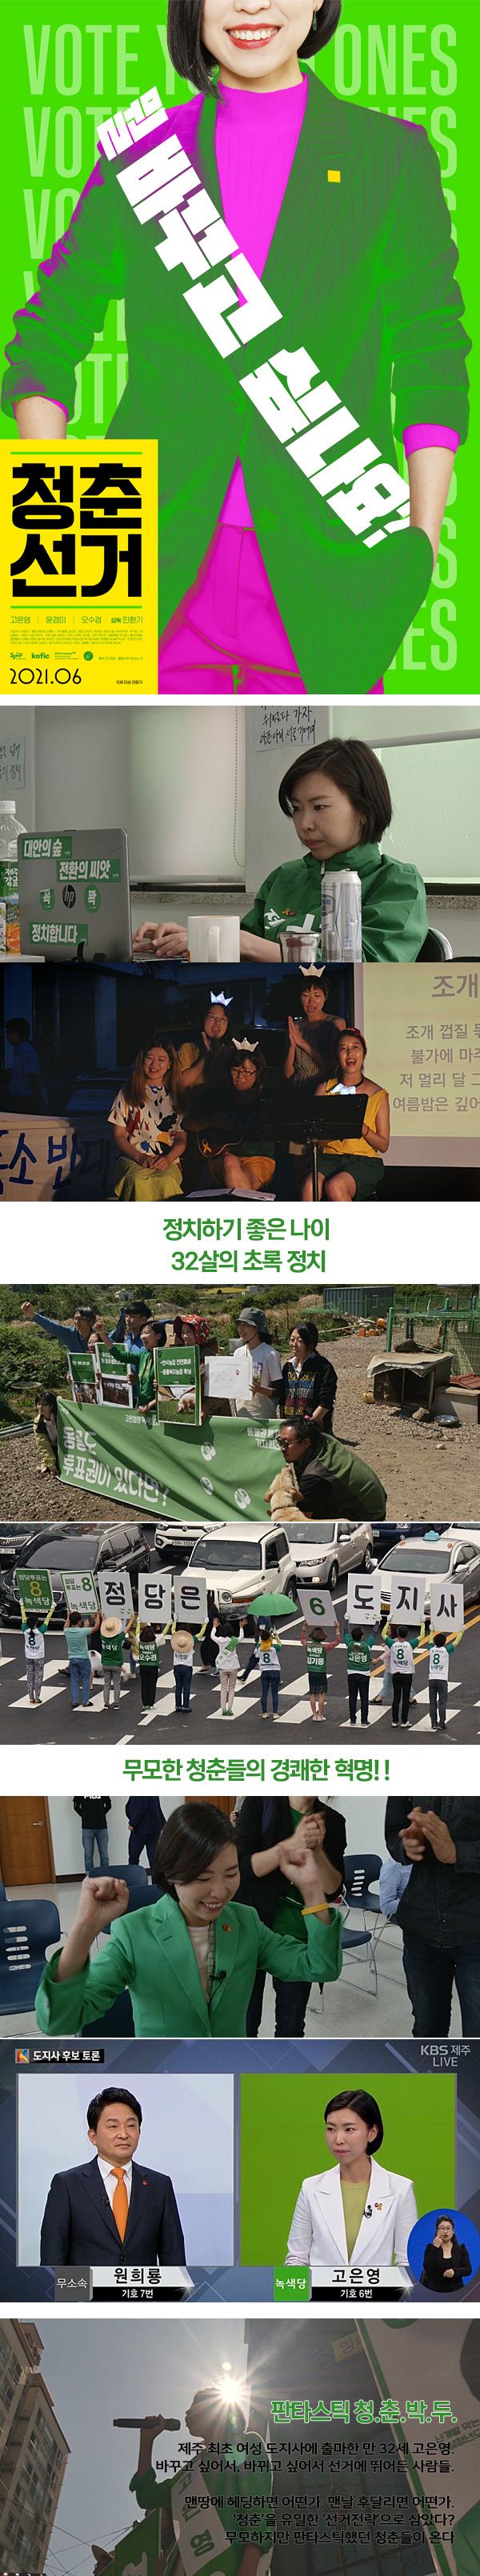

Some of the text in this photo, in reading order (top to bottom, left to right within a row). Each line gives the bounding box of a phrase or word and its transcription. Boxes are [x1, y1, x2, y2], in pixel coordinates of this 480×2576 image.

[23, 23, 140, 96] VOTE
[334, 23, 458, 96] ONES
[96, 86, 169, 161] 뭘
[116, 133, 282, 359] 바꾸고
[11, 463, 142, 530] 청춘
[10, 534, 142, 597] 선거
[10, 615, 31, 624] 고은영
[46, 615, 66, 624] 윤경미
[81, 615, 102, 624] 오수경
[122, 615, 143, 624] 민환기
[10, 667, 82, 685] 2021.06
[293, 704, 313, 725] 가자
[23, 838, 51, 858] 대안의
[52, 838, 63, 858] 숲
[59, 860, 89, 881] 전환의
[89, 859, 111, 880] 씨앗
[32, 924, 78, 943] 정치합니다
[432, 973, 478, 998] 조개
[406, 1025, 434, 1040] 조개
[440, 1023, 468, 1039] 껍질
[410, 1047, 454, 1064] 불가에
[400, 1072, 414, 1088] 저
[418, 1072, 446, 1088] 멀리
[452, 1072, 466, 1088] 달
[393, 1096, 450, 1112] 여름밤은
[63, 1454, 170, 1506] 투표권이 있다면?
[18, 1574, 47, 1582] 정당투표는
[81, 1577, 93, 1592] 8
[30, 1581, 42, 1597] 8
[66, 1583, 82, 1591] 투표는
[23, 1596, 50, 1606] 녹색당
[69, 1600, 96, 1611] 녹색당
[309, 1597, 326, 1616] 6
[139, 1643, 155, 1651] 녹색당
[306, 1646, 322, 1654] 녹색당
[396, 1648, 404, 1660] 8
[139, 1654, 158, 1662] 오수경
[262, 1652, 270, 1663] 8
[348, 1653, 367, 1662] 고은영
[433, 1653, 441, 1665] 8
